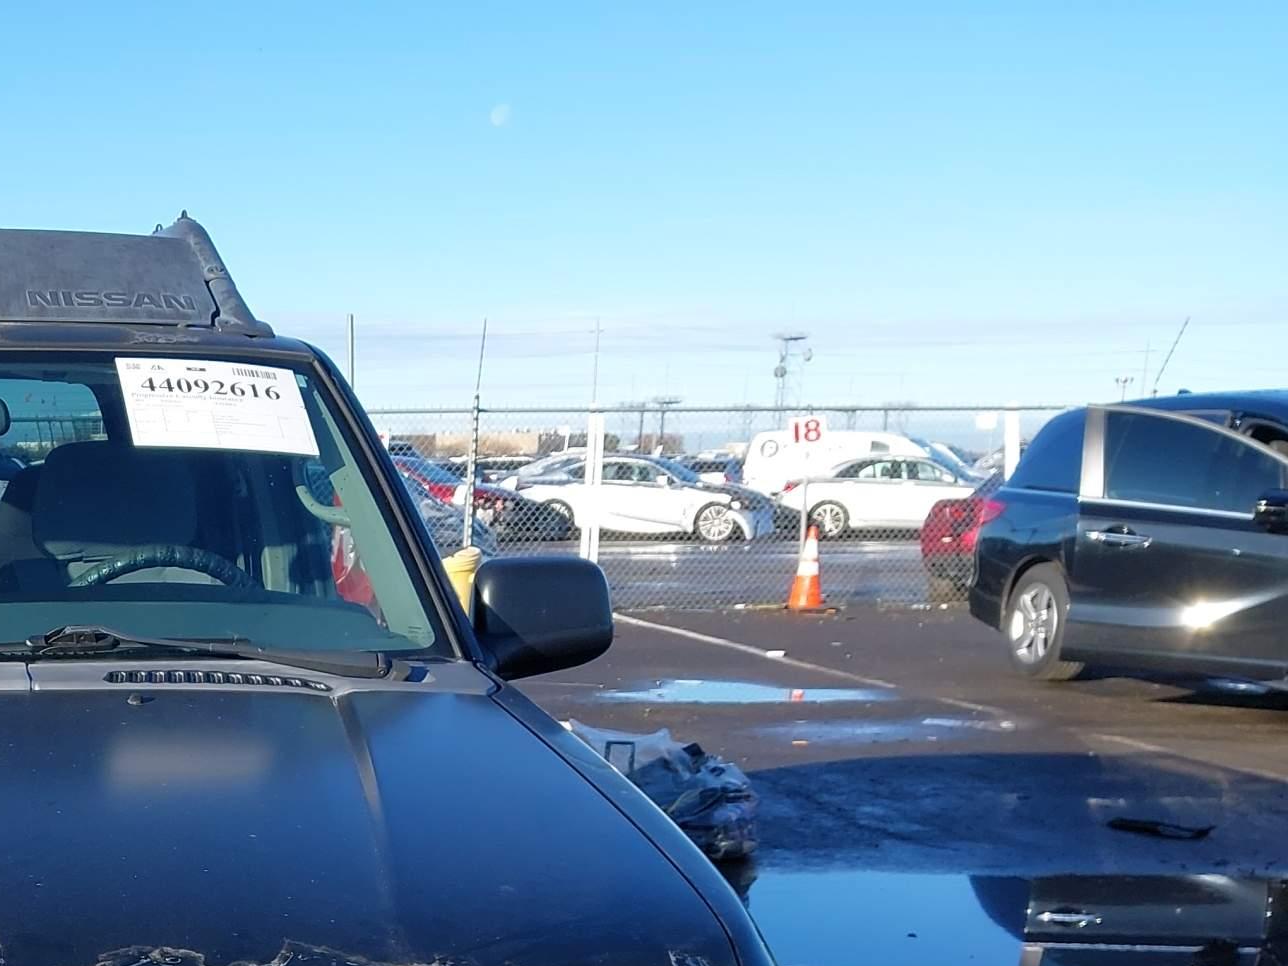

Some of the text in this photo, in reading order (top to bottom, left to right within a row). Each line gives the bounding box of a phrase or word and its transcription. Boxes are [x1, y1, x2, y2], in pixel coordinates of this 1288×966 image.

[26, 289, 196, 311] NISSAN
[141, 377, 281, 401] 44092616
[793, 419, 822, 443] 18
